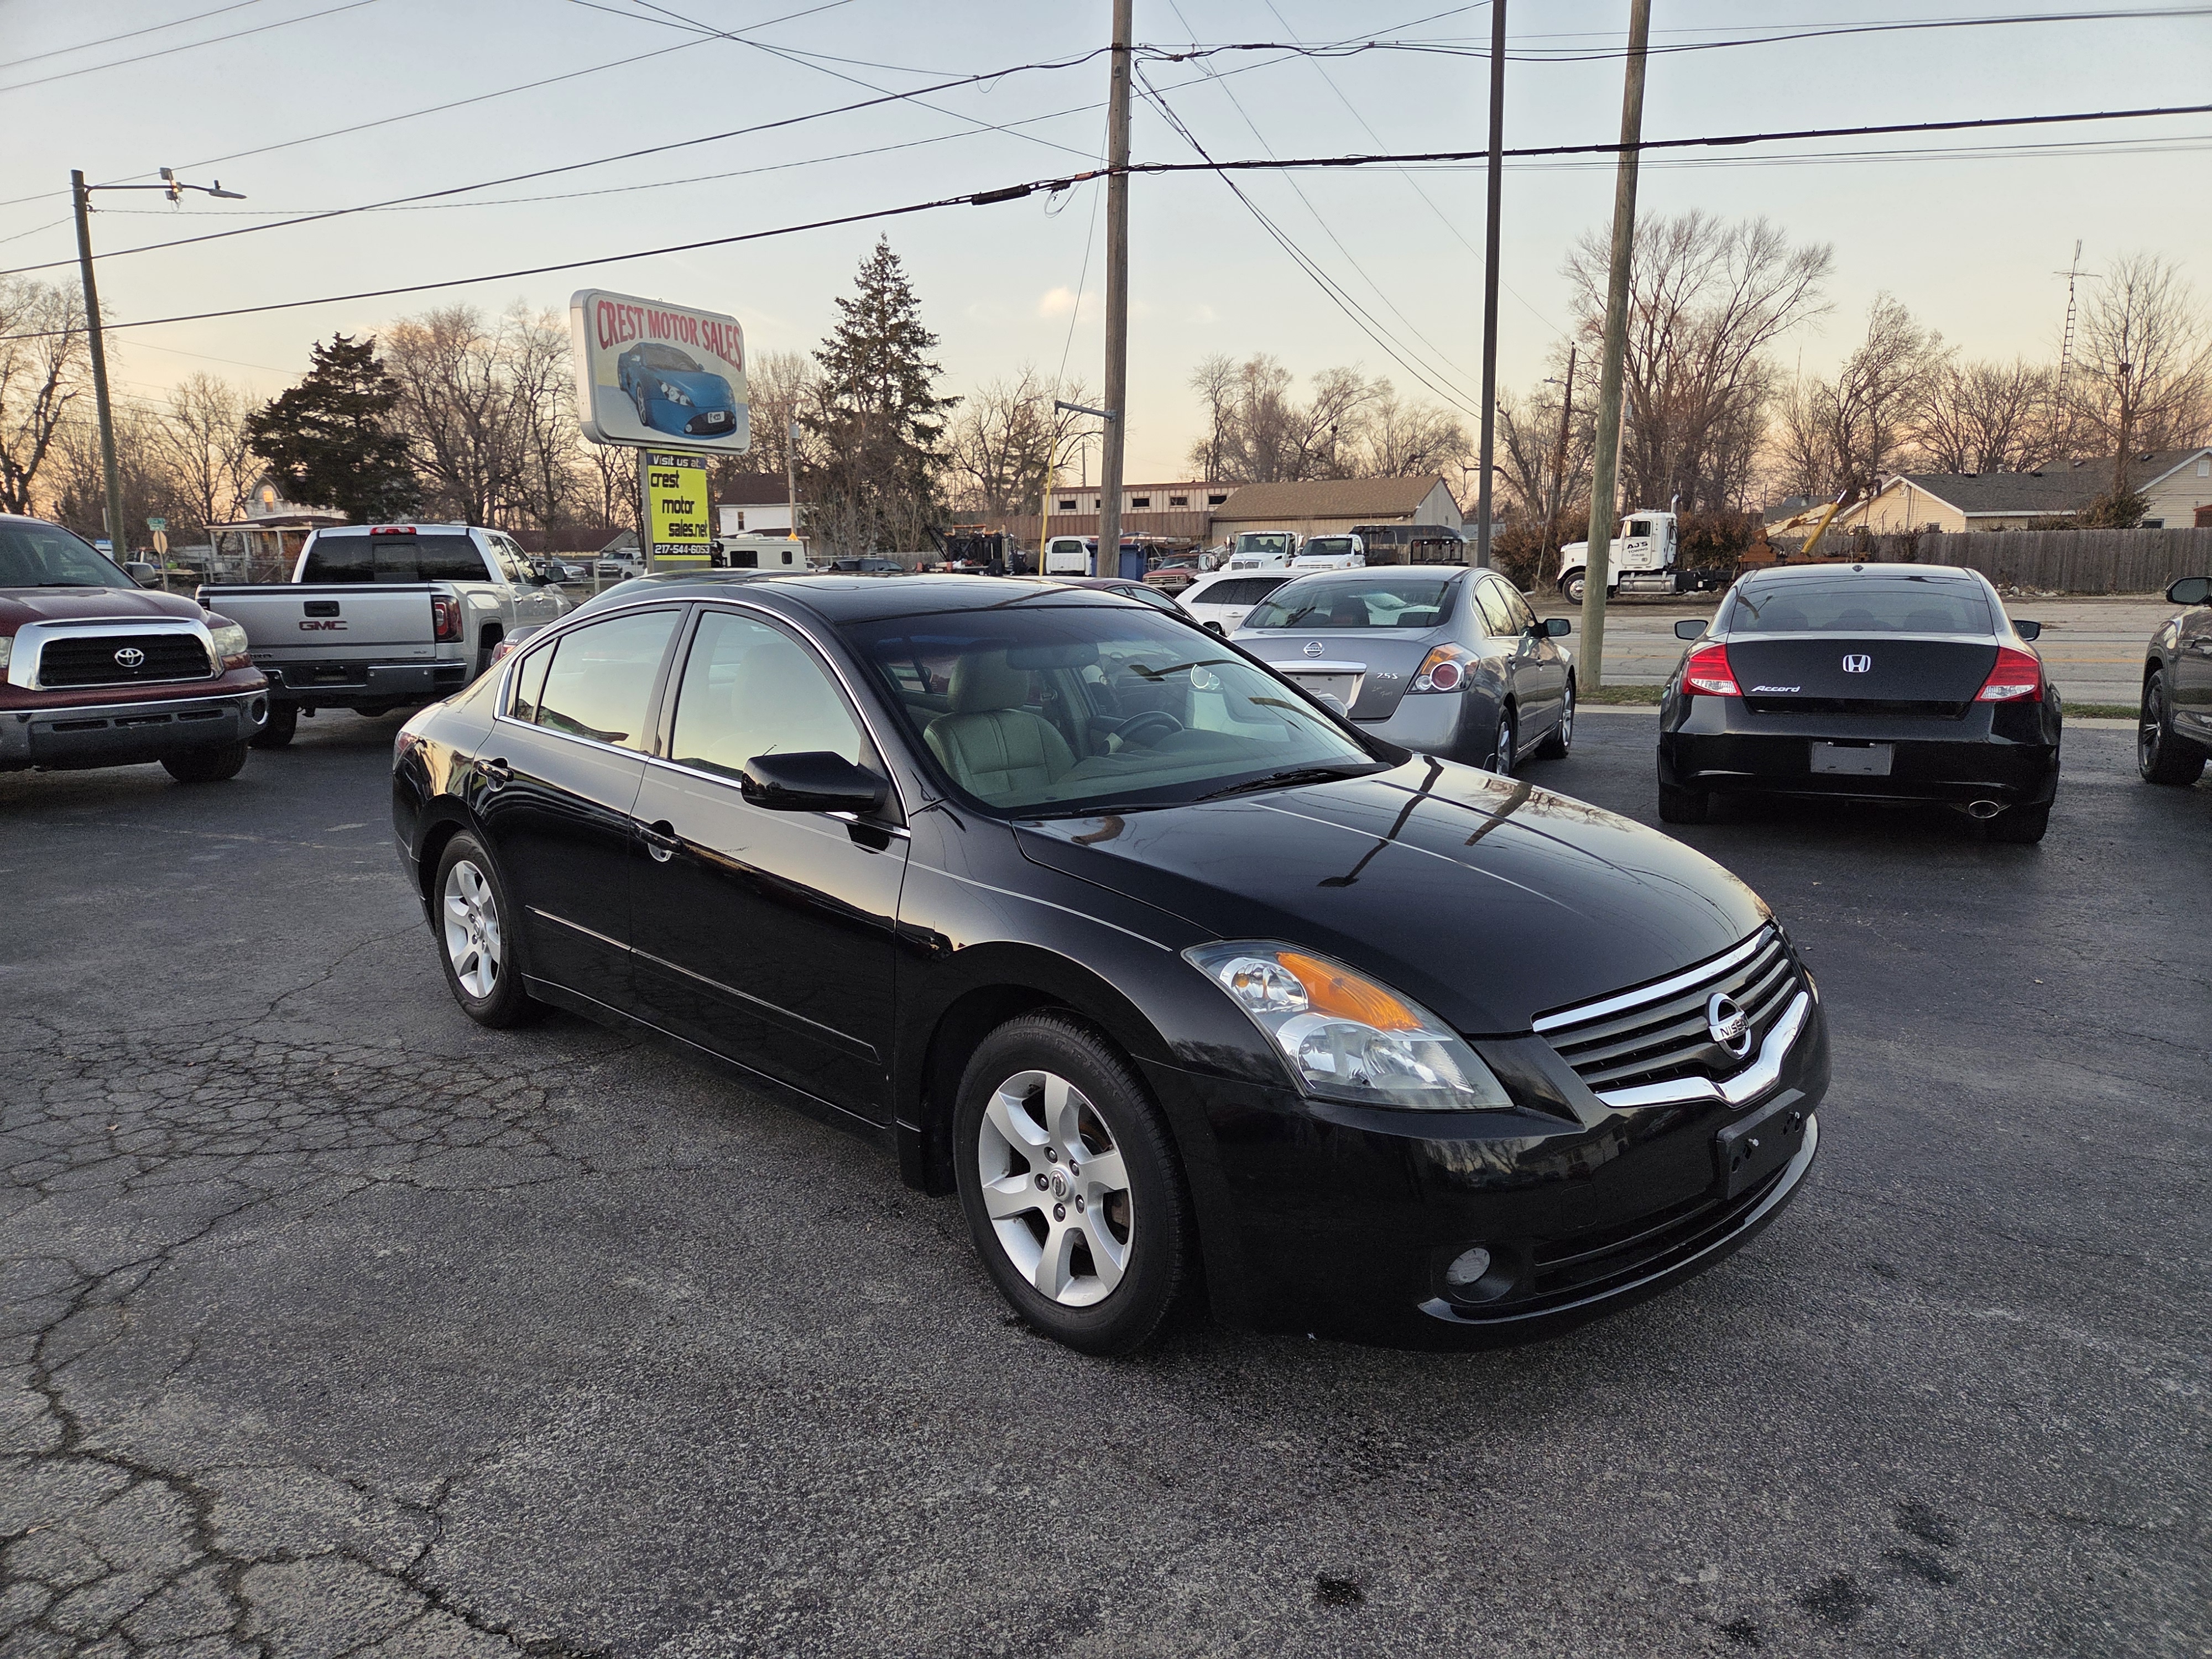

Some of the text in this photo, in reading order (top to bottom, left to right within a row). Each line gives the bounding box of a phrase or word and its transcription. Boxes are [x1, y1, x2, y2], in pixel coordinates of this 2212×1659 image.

[597, 300, 742, 372] CREST MOTOR SALES
[653, 455, 674, 466] Visit
[677, 458, 688, 467] us
[651, 469, 680, 488] crest
[662, 495, 695, 514] motor
[669, 519, 707, 537] sales.net
[655, 545, 709, 554] 217-544-6053
[299, 621, 348, 630] GMC
